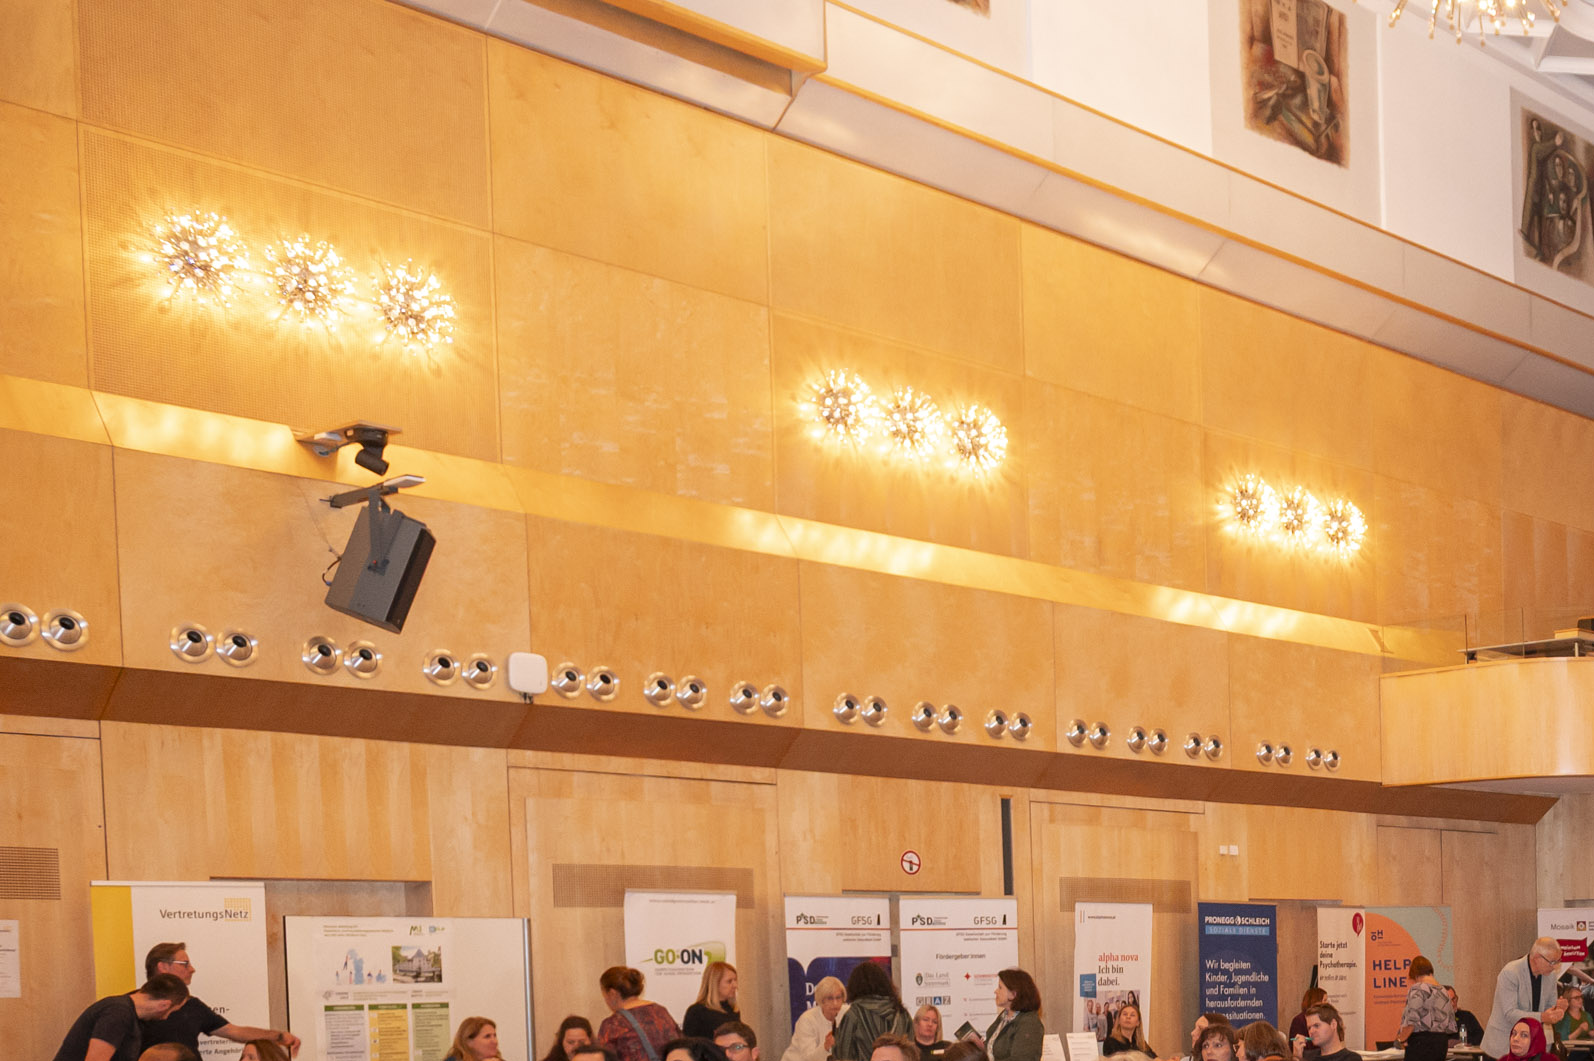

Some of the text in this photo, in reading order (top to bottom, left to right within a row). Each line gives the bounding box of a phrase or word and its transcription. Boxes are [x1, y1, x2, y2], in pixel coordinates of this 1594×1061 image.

[160, 909, 249, 921] VertretungsNetz
[851, 916, 872, 925] GFSG
[974, 917, 997, 925] GFSG
[1205, 916, 1234, 924] PRONEGG
[1320, 941, 1335, 949] Starte
[1099, 953, 1119, 963] alpha
[1099, 965, 1124, 974] Ich bin
[1206, 960, 1251, 971] Wir begleiten
[1373, 960, 1411, 970] HELP
[1098, 977, 1120, 986] dabei.
[1206, 972, 1269, 984] Kinder, Jugendliche
[1374, 977, 1408, 988] LINE
[1206, 985, 1256, 994] und Familien in
[1206, 997, 1263, 1007] herausfordernden
